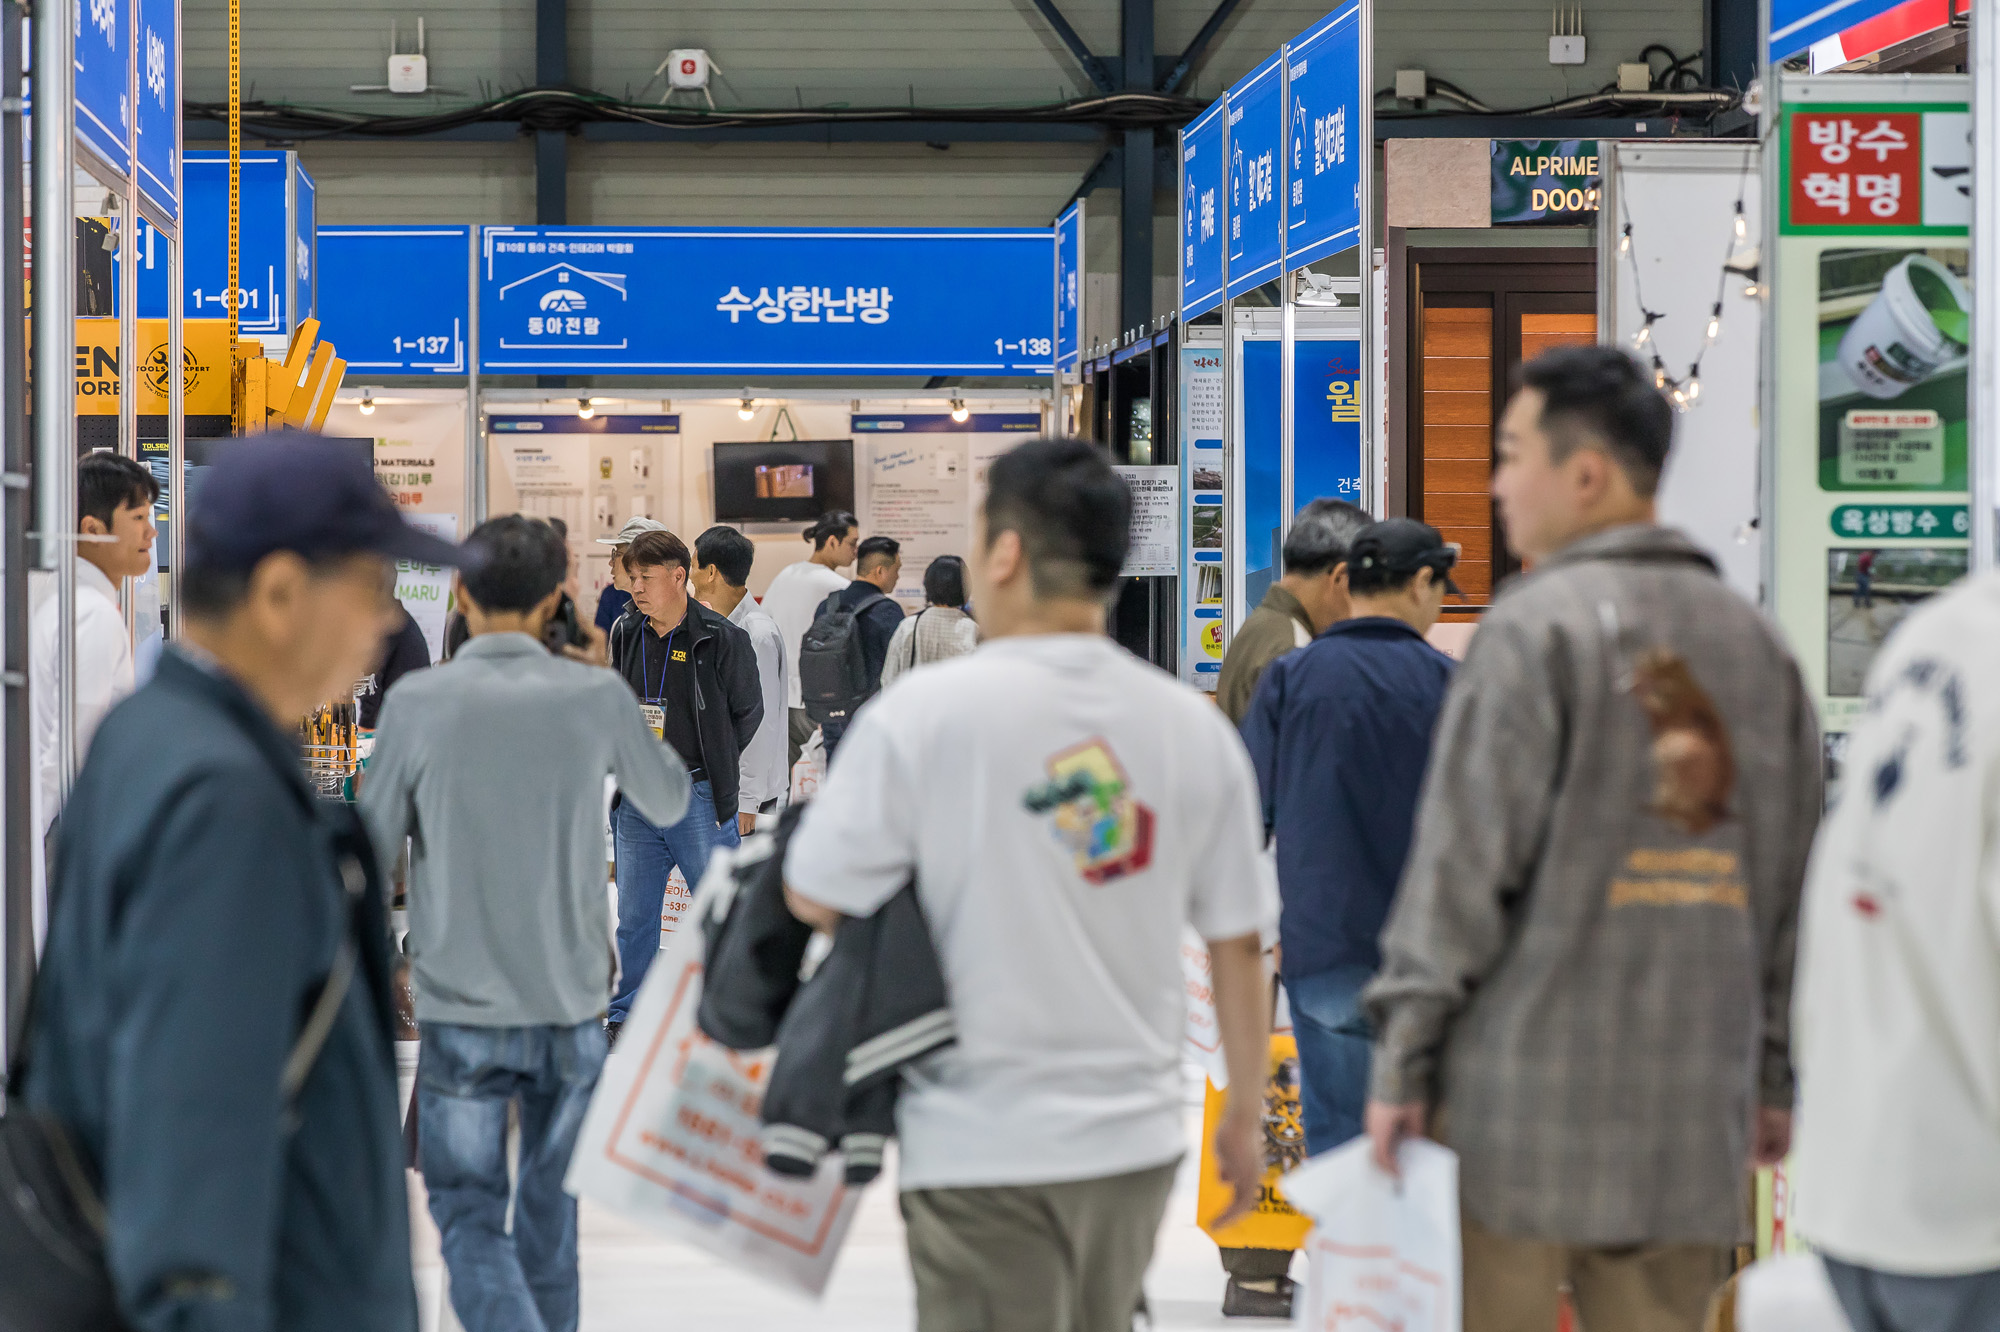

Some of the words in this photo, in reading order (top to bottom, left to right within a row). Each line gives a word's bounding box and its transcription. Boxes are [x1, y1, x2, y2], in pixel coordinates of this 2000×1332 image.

[1808, 119, 1909, 164] 방수
[1509, 156, 1599, 176] ALPRIME
[1800, 172, 1902, 217] 혁명
[192, 288, 258, 309] 1-601
[716, 285, 893, 324] 수상한난방
[528, 316, 601, 335] 동아전람
[392, 336, 449, 355] 1-137
[994, 338, 1051, 356] 1-138
[381, 458, 434, 467] MATERIALS
[1841, 509, 1940, 534] 옥상방수
[399, 584, 440, 601] MARU
